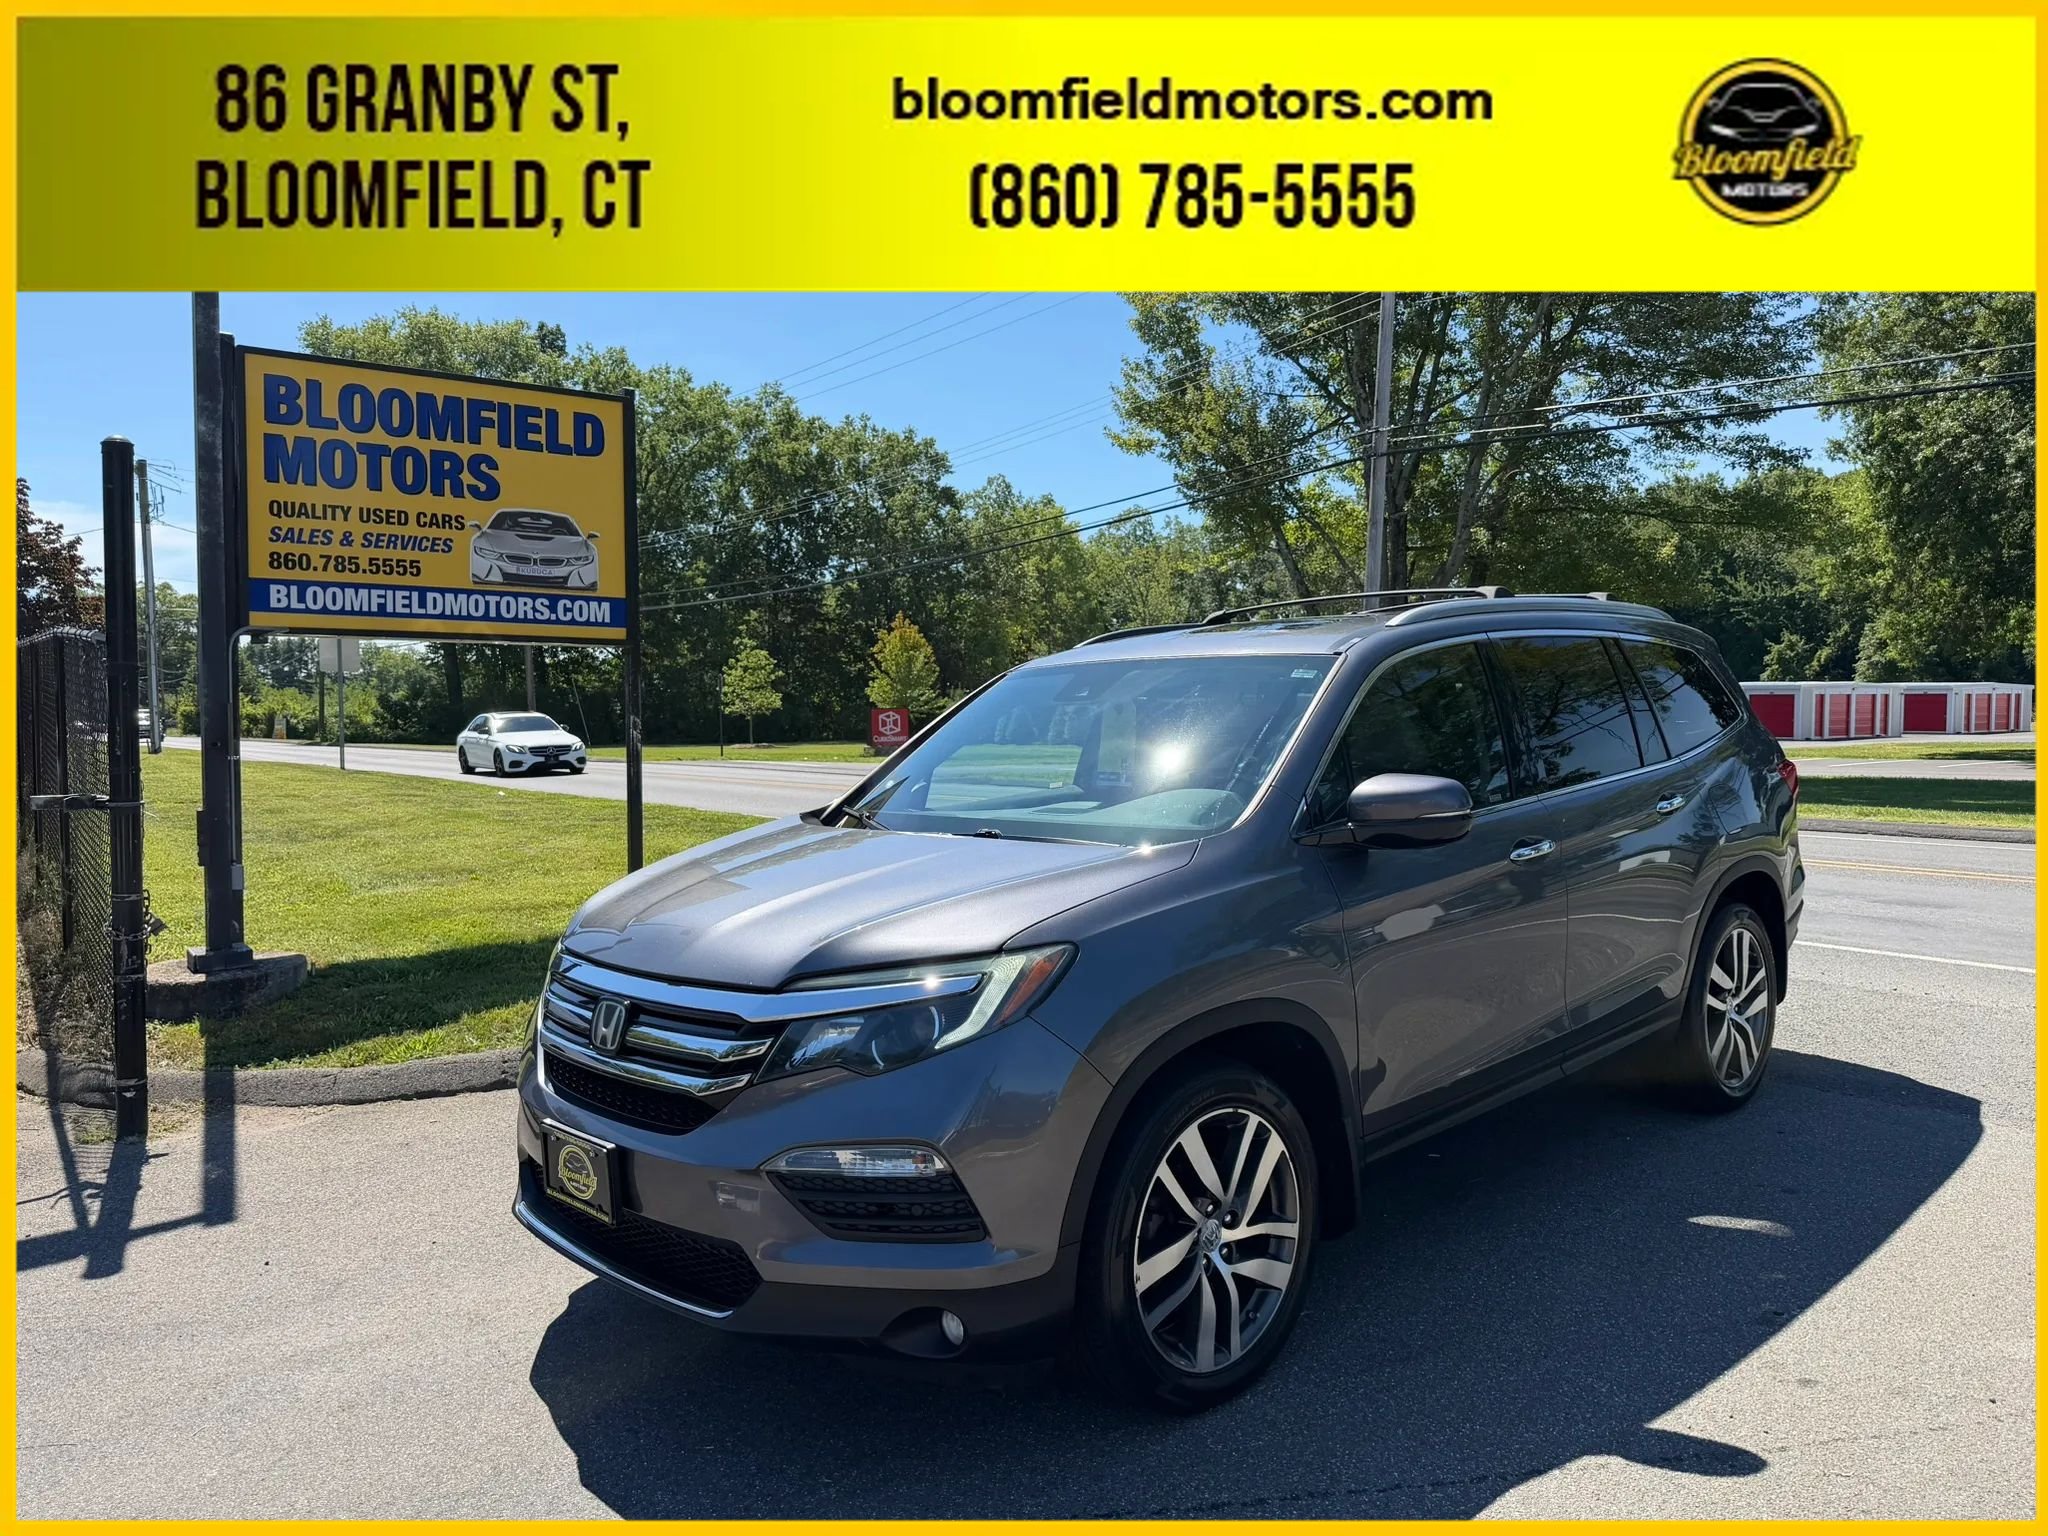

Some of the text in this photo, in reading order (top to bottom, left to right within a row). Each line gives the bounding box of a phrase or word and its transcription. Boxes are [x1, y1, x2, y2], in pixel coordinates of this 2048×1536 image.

[263, 373, 606, 457] BLOOMFIELD
[263, 433, 501, 502] MOTORS
[268, 499, 466, 531] QUALITY USED CARS
[268, 526, 454, 554] SALES & SERVICES
[268, 551, 422, 578] 860.785.5555
[269, 583, 612, 624] BLOOMFIELDMOTORS.COM
[560, 1166, 597, 1188] Bloomfield
